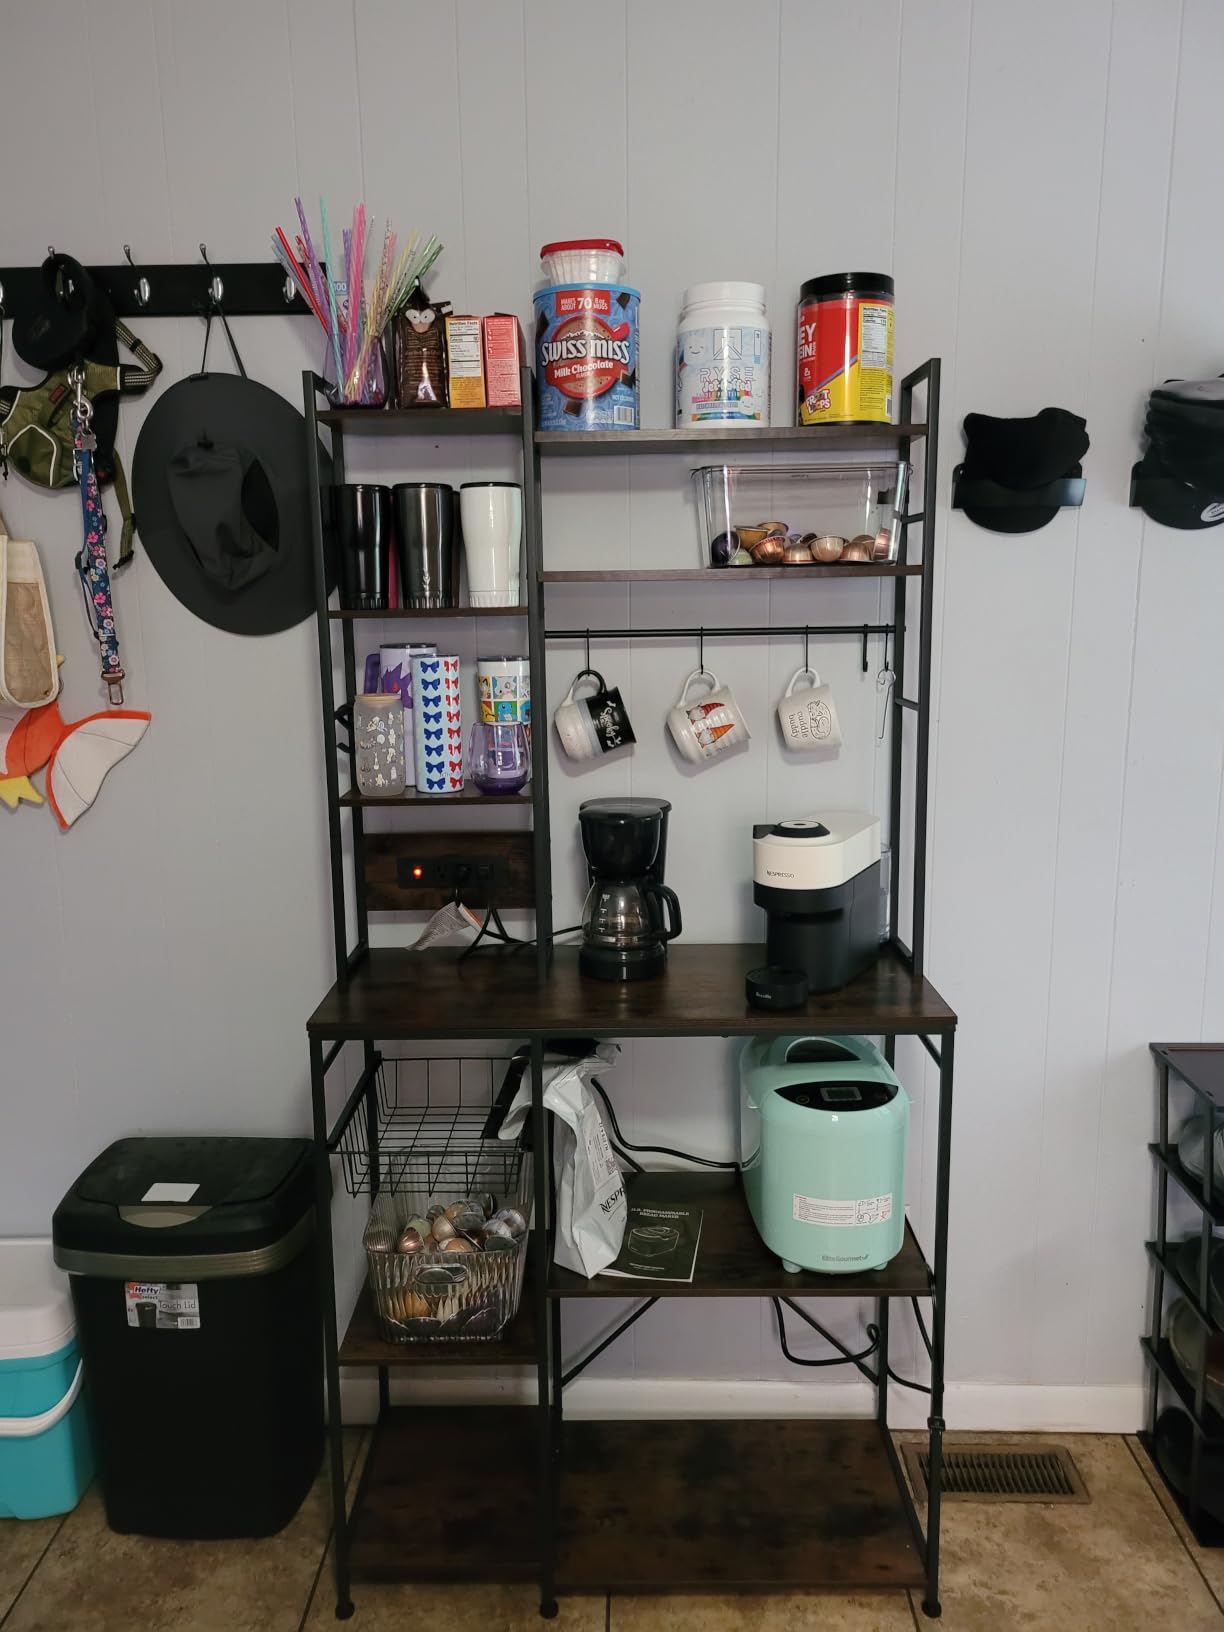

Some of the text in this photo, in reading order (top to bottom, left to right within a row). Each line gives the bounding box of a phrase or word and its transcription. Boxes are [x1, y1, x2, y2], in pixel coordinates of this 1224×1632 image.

[560, 303, 577, 311] ABOUT
[577, 297, 593, 310] 70
[593, 302, 609, 310] MUGS
[541, 339, 630, 367] SWISS MISS
[554, 360, 614, 379] Milk Chocolate
[699, 366, 754, 382] RYSE
[788, 713, 800, 739] buddy
[797, 710, 809, 738] cuddle
[766, 870, 795, 878] NESPRESSO
[134, 1286, 159, 1294] Hefty
[158, 1299, 196, 1310] Touch Lid
